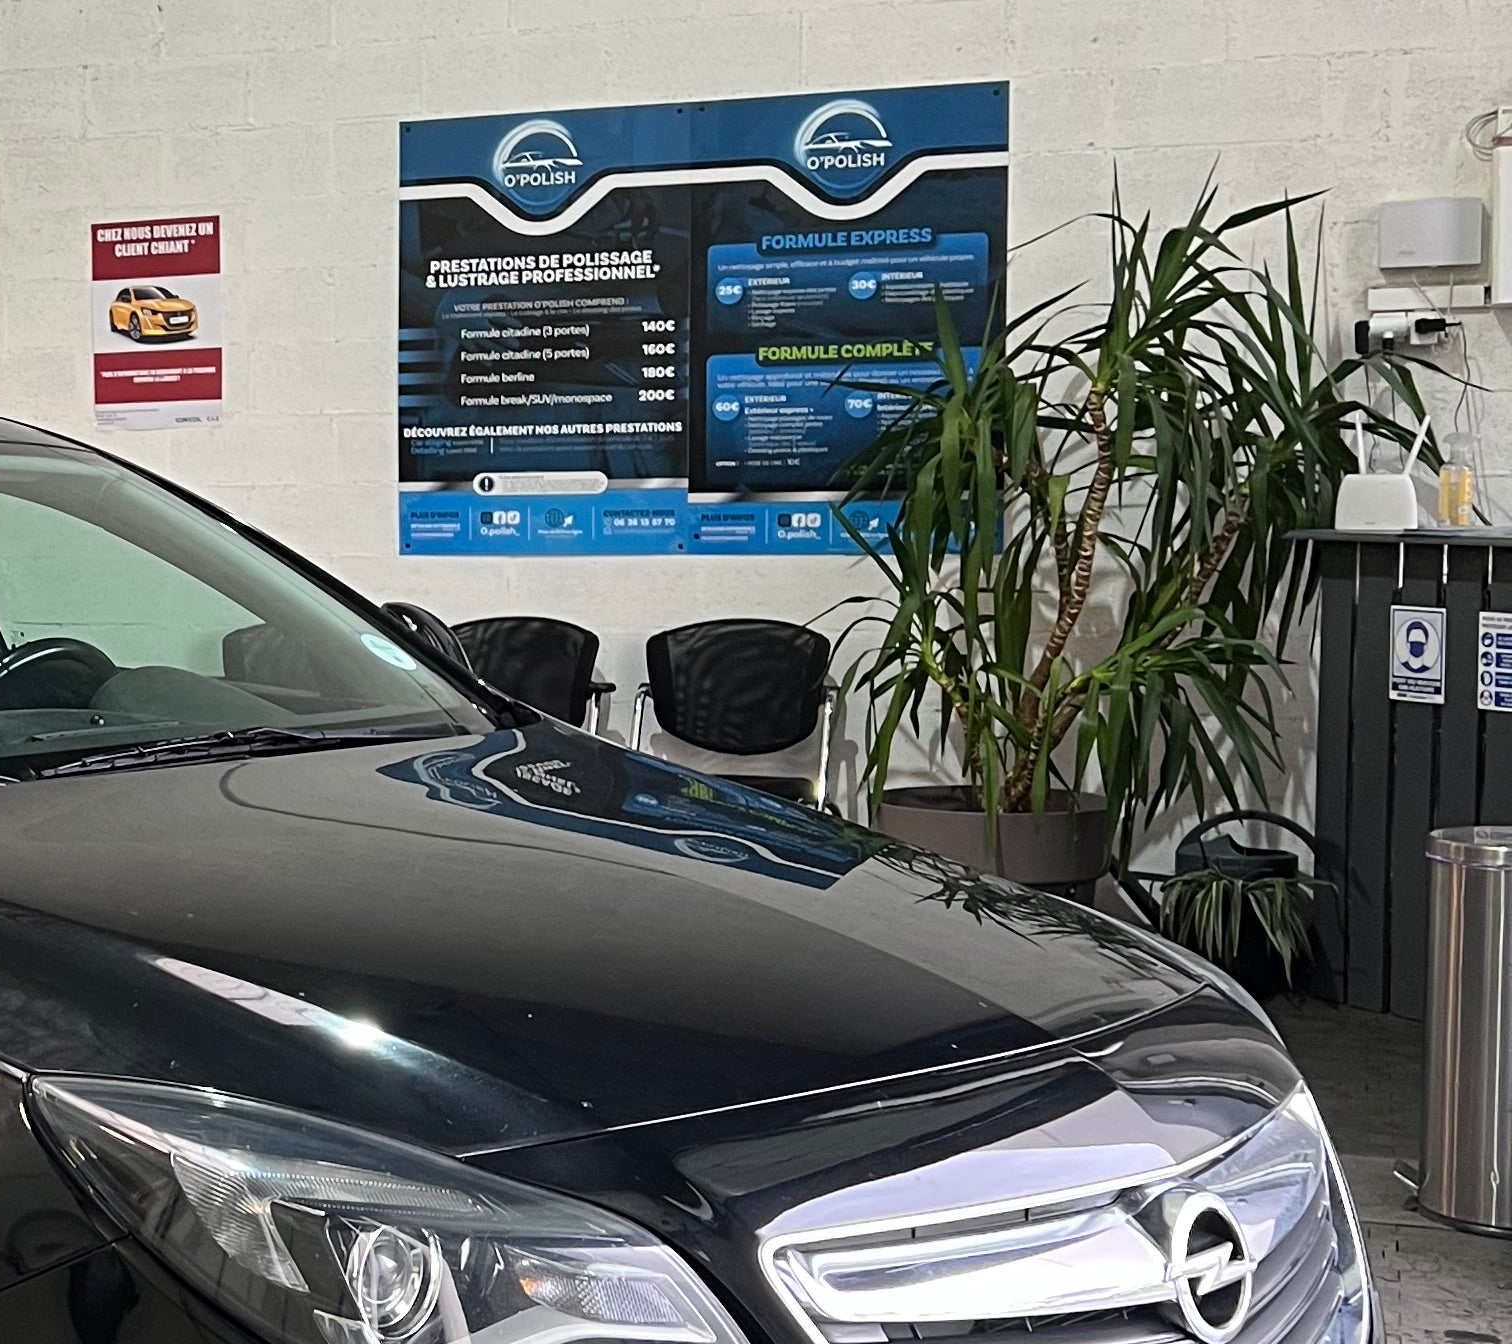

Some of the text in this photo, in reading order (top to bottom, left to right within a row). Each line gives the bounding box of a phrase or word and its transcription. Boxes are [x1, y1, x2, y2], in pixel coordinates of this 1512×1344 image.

[97, 222, 214, 243] CHEZ NOUS DEVENEZ UN
[761, 227, 933, 251] FORMULE EXPRESS
[115, 242, 149, 258] CLIENT
[151, 240, 190, 256] CHIANT
[430, 250, 653, 274] PRESTATIONS DE POLISSAGE
[425, 274, 437, 288] &
[439, 270, 520, 288] LUSTRAGE
[850, 279, 877, 291] 30€
[718, 285, 743, 296] 25€
[460, 328, 500, 340] Formule
[501, 327, 541, 339] citadine
[554, 325, 590, 338] portes)
[641, 320, 676, 333] 140€
[460, 351, 500, 362] Formule
[501, 349, 541, 361] citadine
[554, 347, 590, 360] portes)
[641, 343, 676, 356] 160€
[758, 345, 838, 362] FORMULE
[460, 366, 676, 384] Formule berline 180€
[460, 389, 676, 407] Formule break/SUV/monospace 200€
[847, 398, 873, 409] 70€
[403, 421, 683, 439] DÉCOUVREZ ÉGALEMENT NOS AUTRES PRESTATIONS
